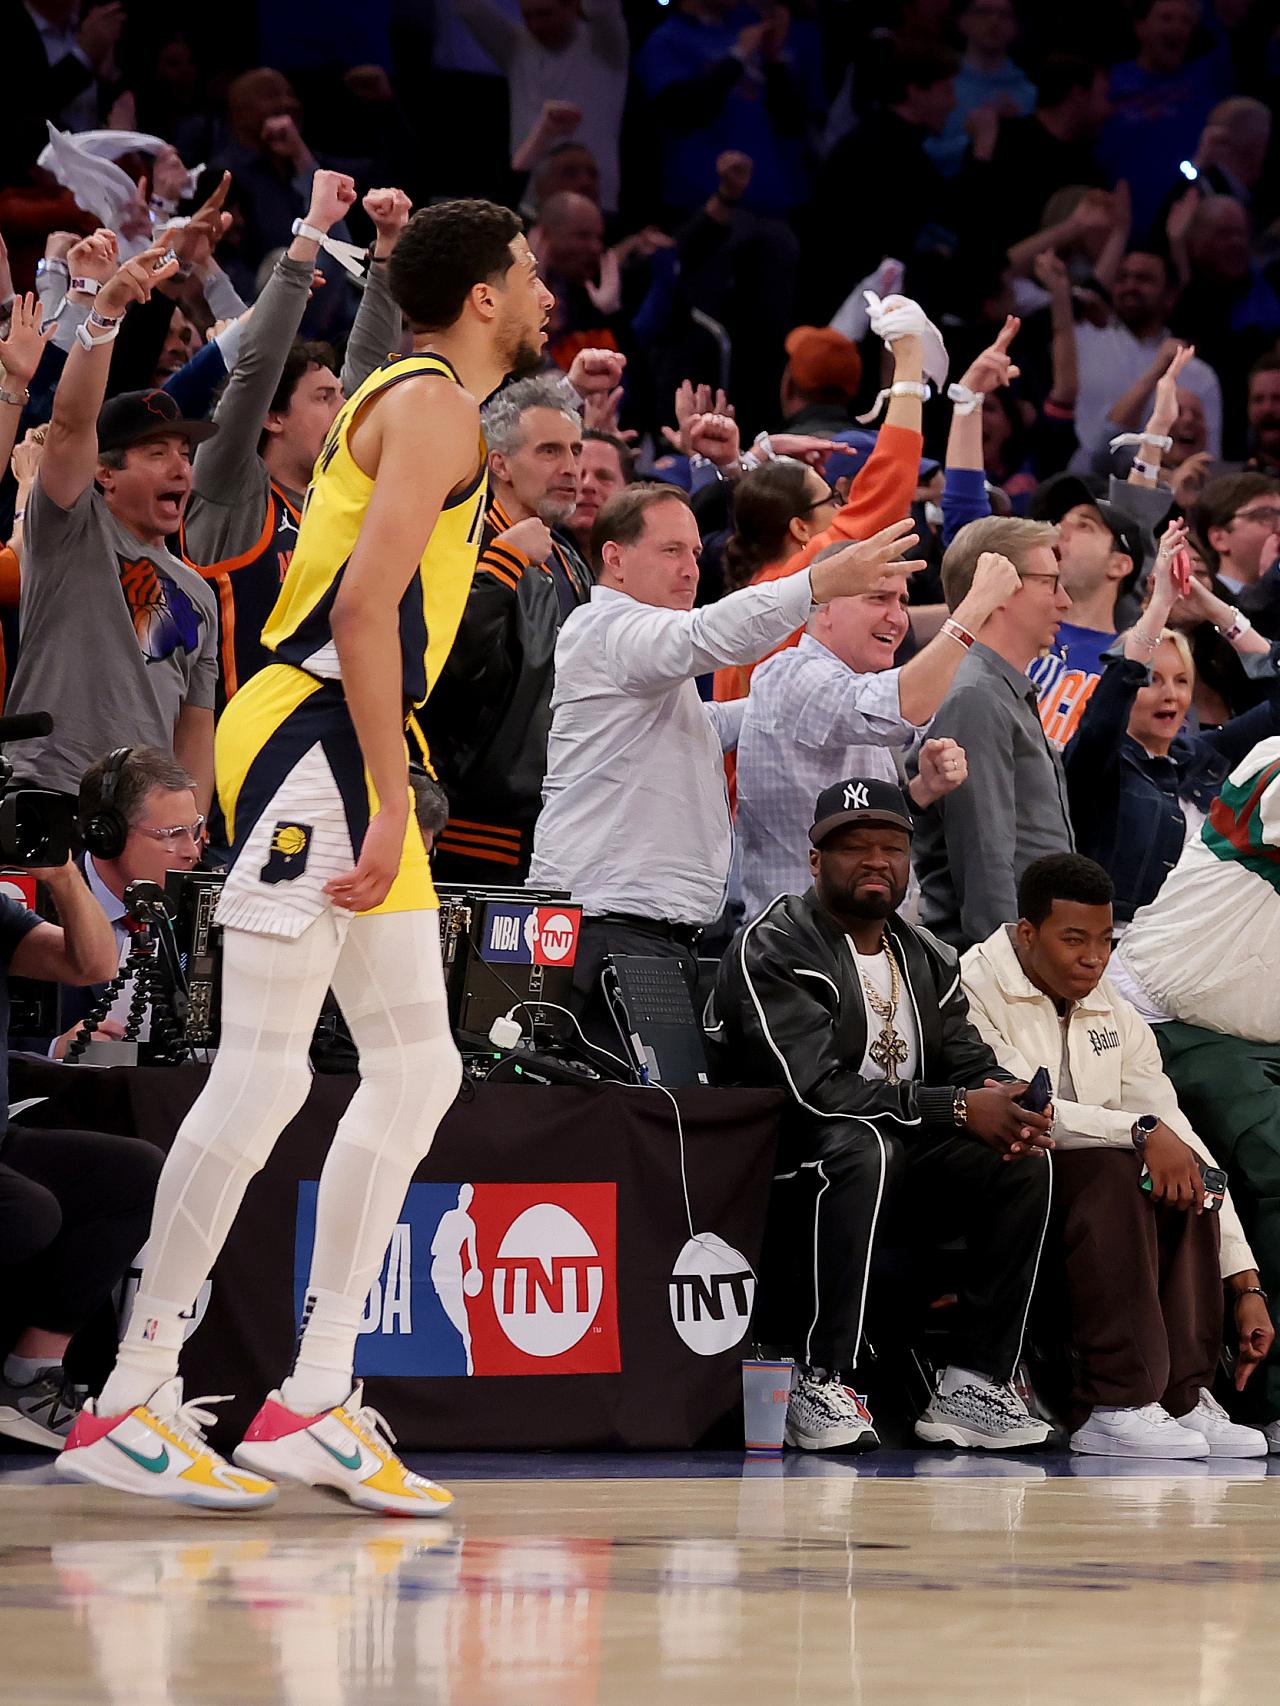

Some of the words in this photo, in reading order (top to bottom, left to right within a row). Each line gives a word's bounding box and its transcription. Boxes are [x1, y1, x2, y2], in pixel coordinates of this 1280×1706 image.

[843, 782, 870, 809] NY
[489, 915, 520, 951] NBA
[1087, 1026, 1120, 1056] Palm
[493, 1256, 603, 1315] TNT
[669, 1270, 757, 1322] TNT
